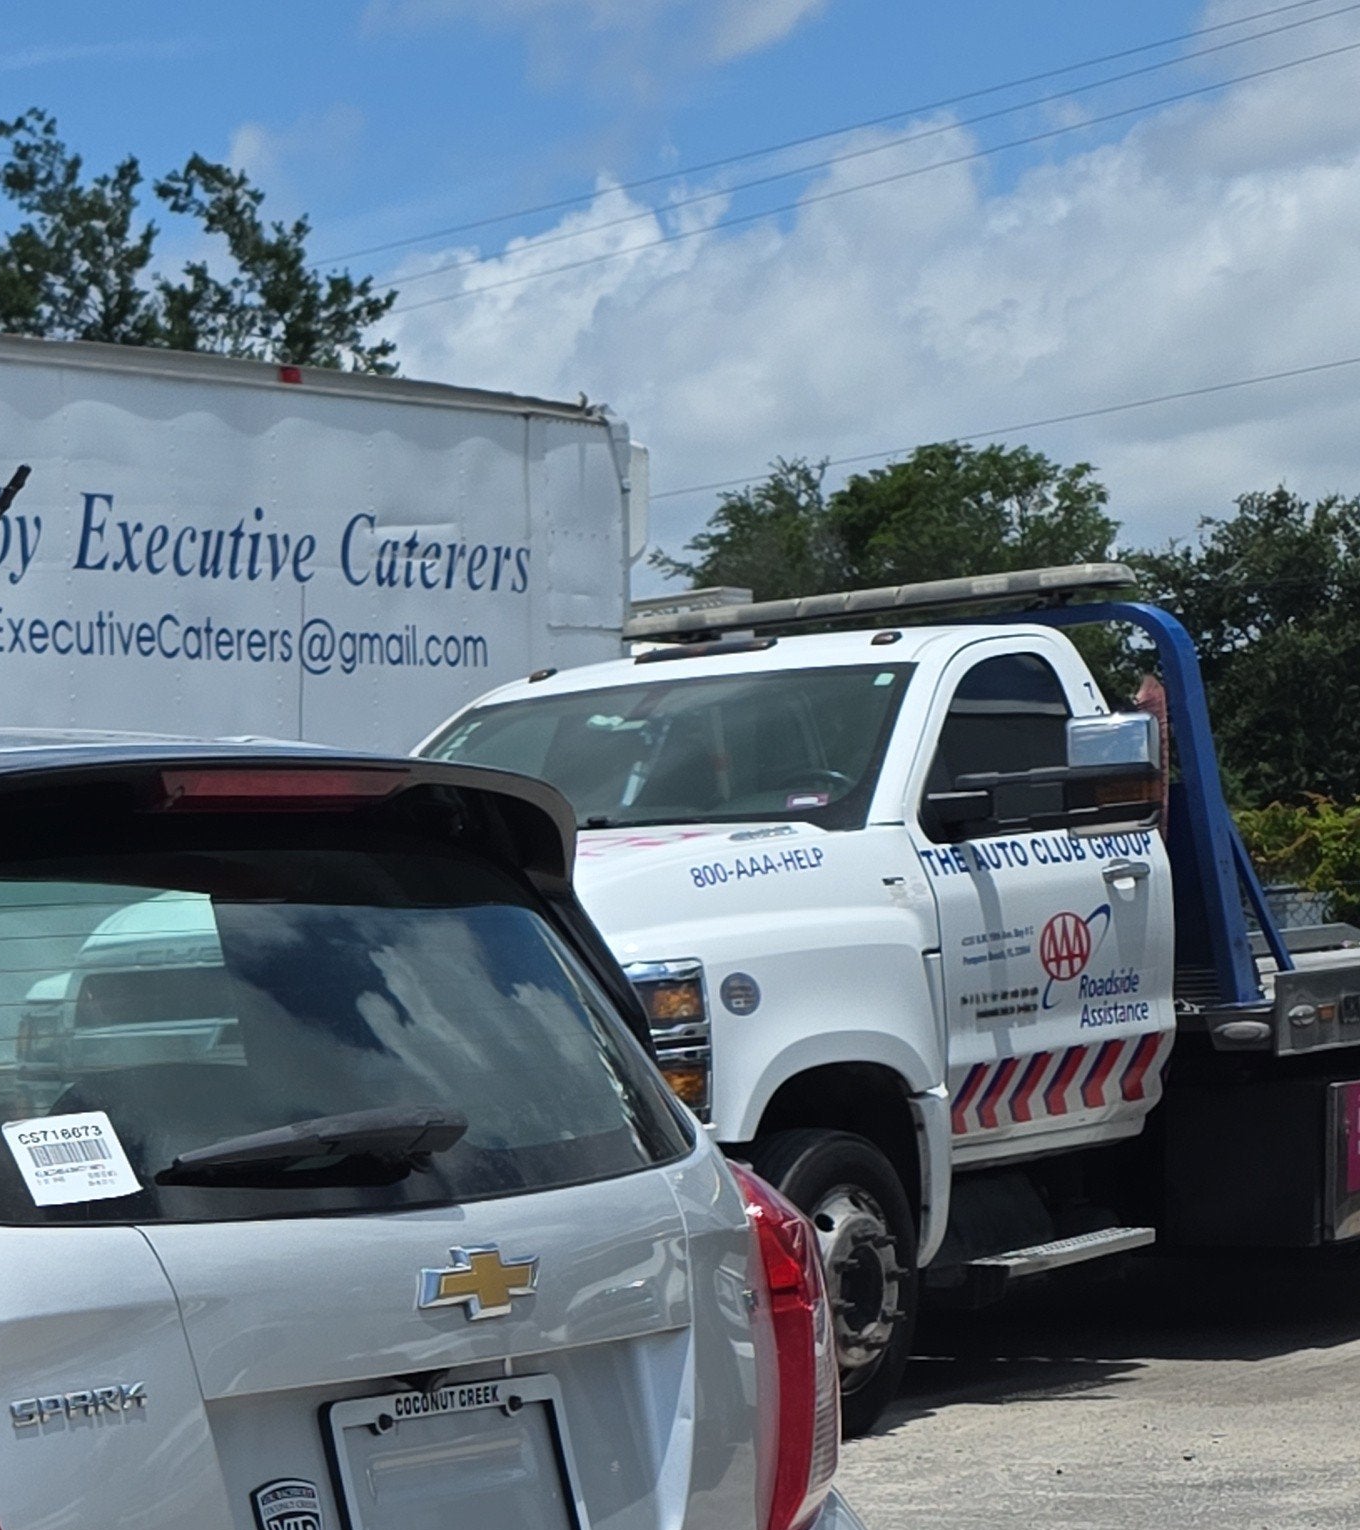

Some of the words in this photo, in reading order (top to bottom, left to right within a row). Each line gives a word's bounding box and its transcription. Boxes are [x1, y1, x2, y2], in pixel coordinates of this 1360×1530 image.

[74, 491, 316, 583] Executive
[341, 513, 530, 594] Caterers
[689, 846, 824, 888] 800-AAA-HELP
[920, 848, 970, 876] THE
[974, 839, 1029, 871] AUTO
[1031, 833, 1086, 865] CLUB
[1088, 831, 1152, 860] GROUP
[1044, 916, 1087, 978] AAA
[1080, 967, 1140, 999] Roadside
[1081, 1001, 1149, 1028] Assistance
[10, 1381, 147, 1427] SPARK
[395, 1391, 455, 1416] COCONUT
[458, 1385, 500, 1407] CREEK
